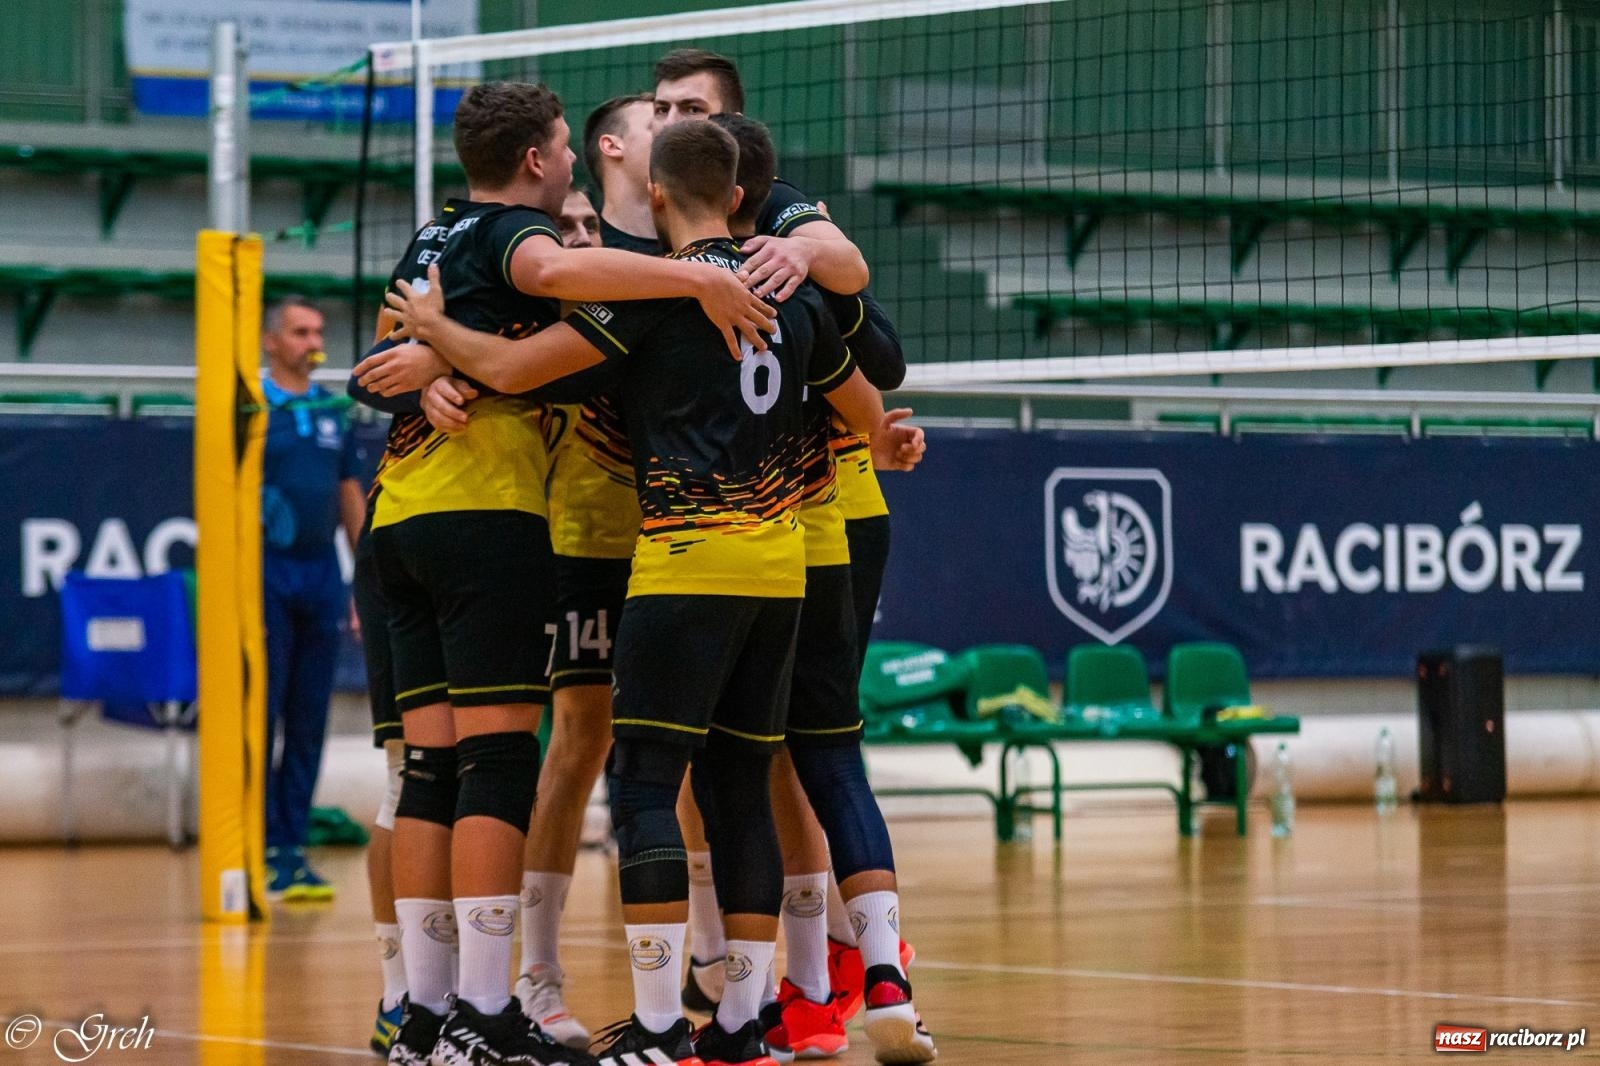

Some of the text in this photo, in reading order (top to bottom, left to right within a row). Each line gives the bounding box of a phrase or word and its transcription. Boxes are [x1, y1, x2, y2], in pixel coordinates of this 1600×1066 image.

[740, 318, 783, 415] 6
[21, 517, 198, 598] RAC
[1241, 501, 1584, 593] RACIBÓRZ
[566, 610, 612, 660] 14
